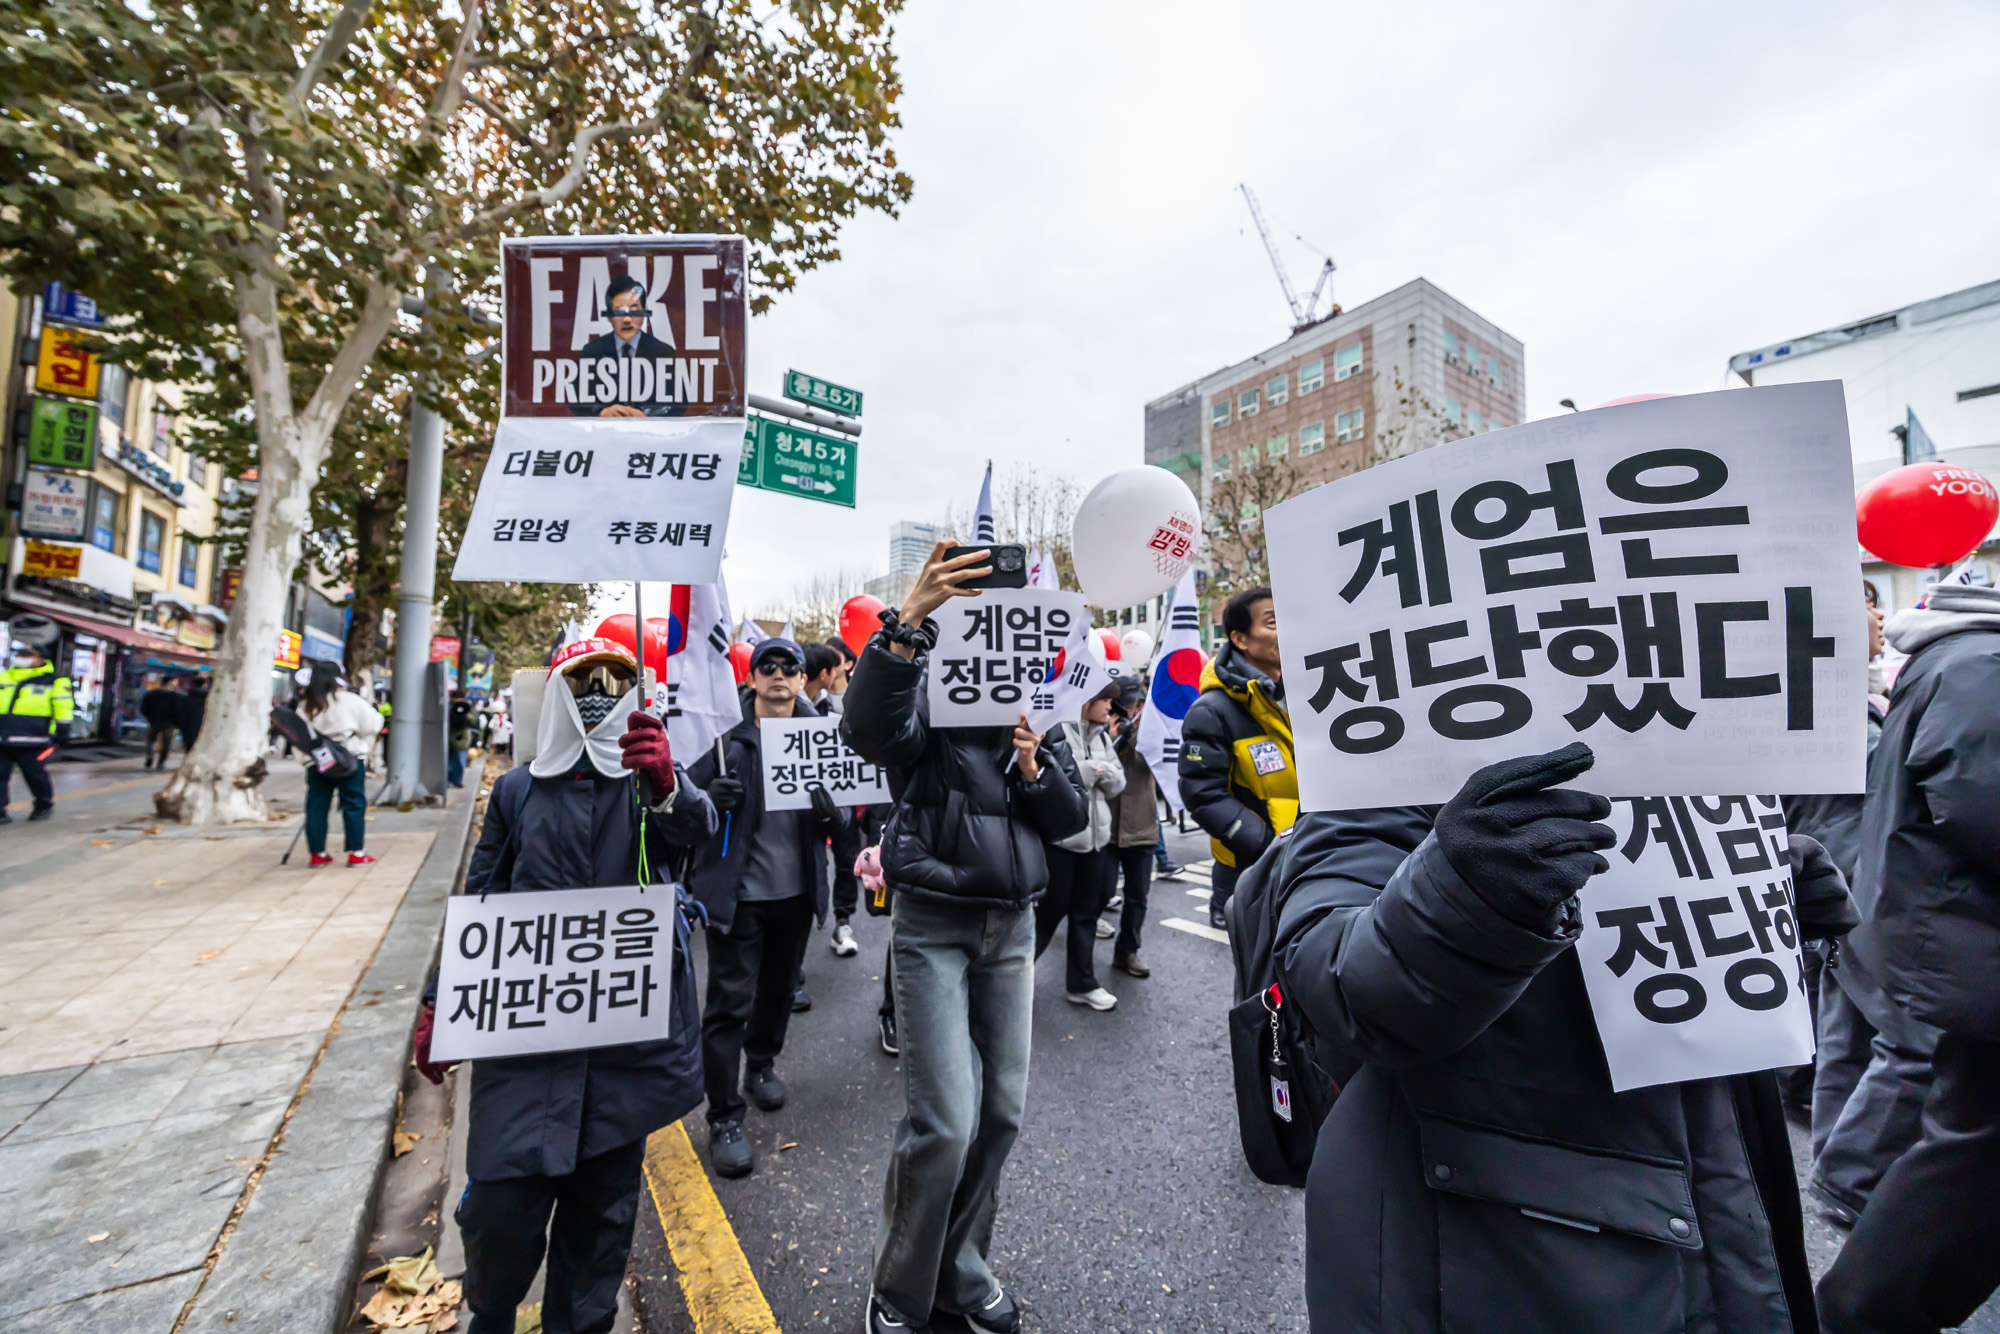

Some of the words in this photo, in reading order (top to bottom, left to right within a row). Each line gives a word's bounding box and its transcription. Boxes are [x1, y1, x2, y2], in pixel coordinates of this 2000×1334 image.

[530, 254, 720, 351] FAKE
[532, 357, 719, 404] PRESIDENT
[794, 373, 859, 411] 종로5가
[502, 450, 594, 478] 더불어
[627, 452, 722, 481] 현지당
[775, 431, 847, 466] 청계5가
[493, 519, 570, 543] 김일성
[608, 521, 713, 547] 추종세력
[1338, 447, 1750, 609] 계엄은
[962, 604, 1071, 652] 계엄은
[1304, 586, 1836, 755] 정당했다
[783, 728, 861, 760] 계엄
[771, 760, 886, 795] 정당했다
[459, 908, 660, 970] 이재명을
[449, 965, 658, 1032] 재판하라
